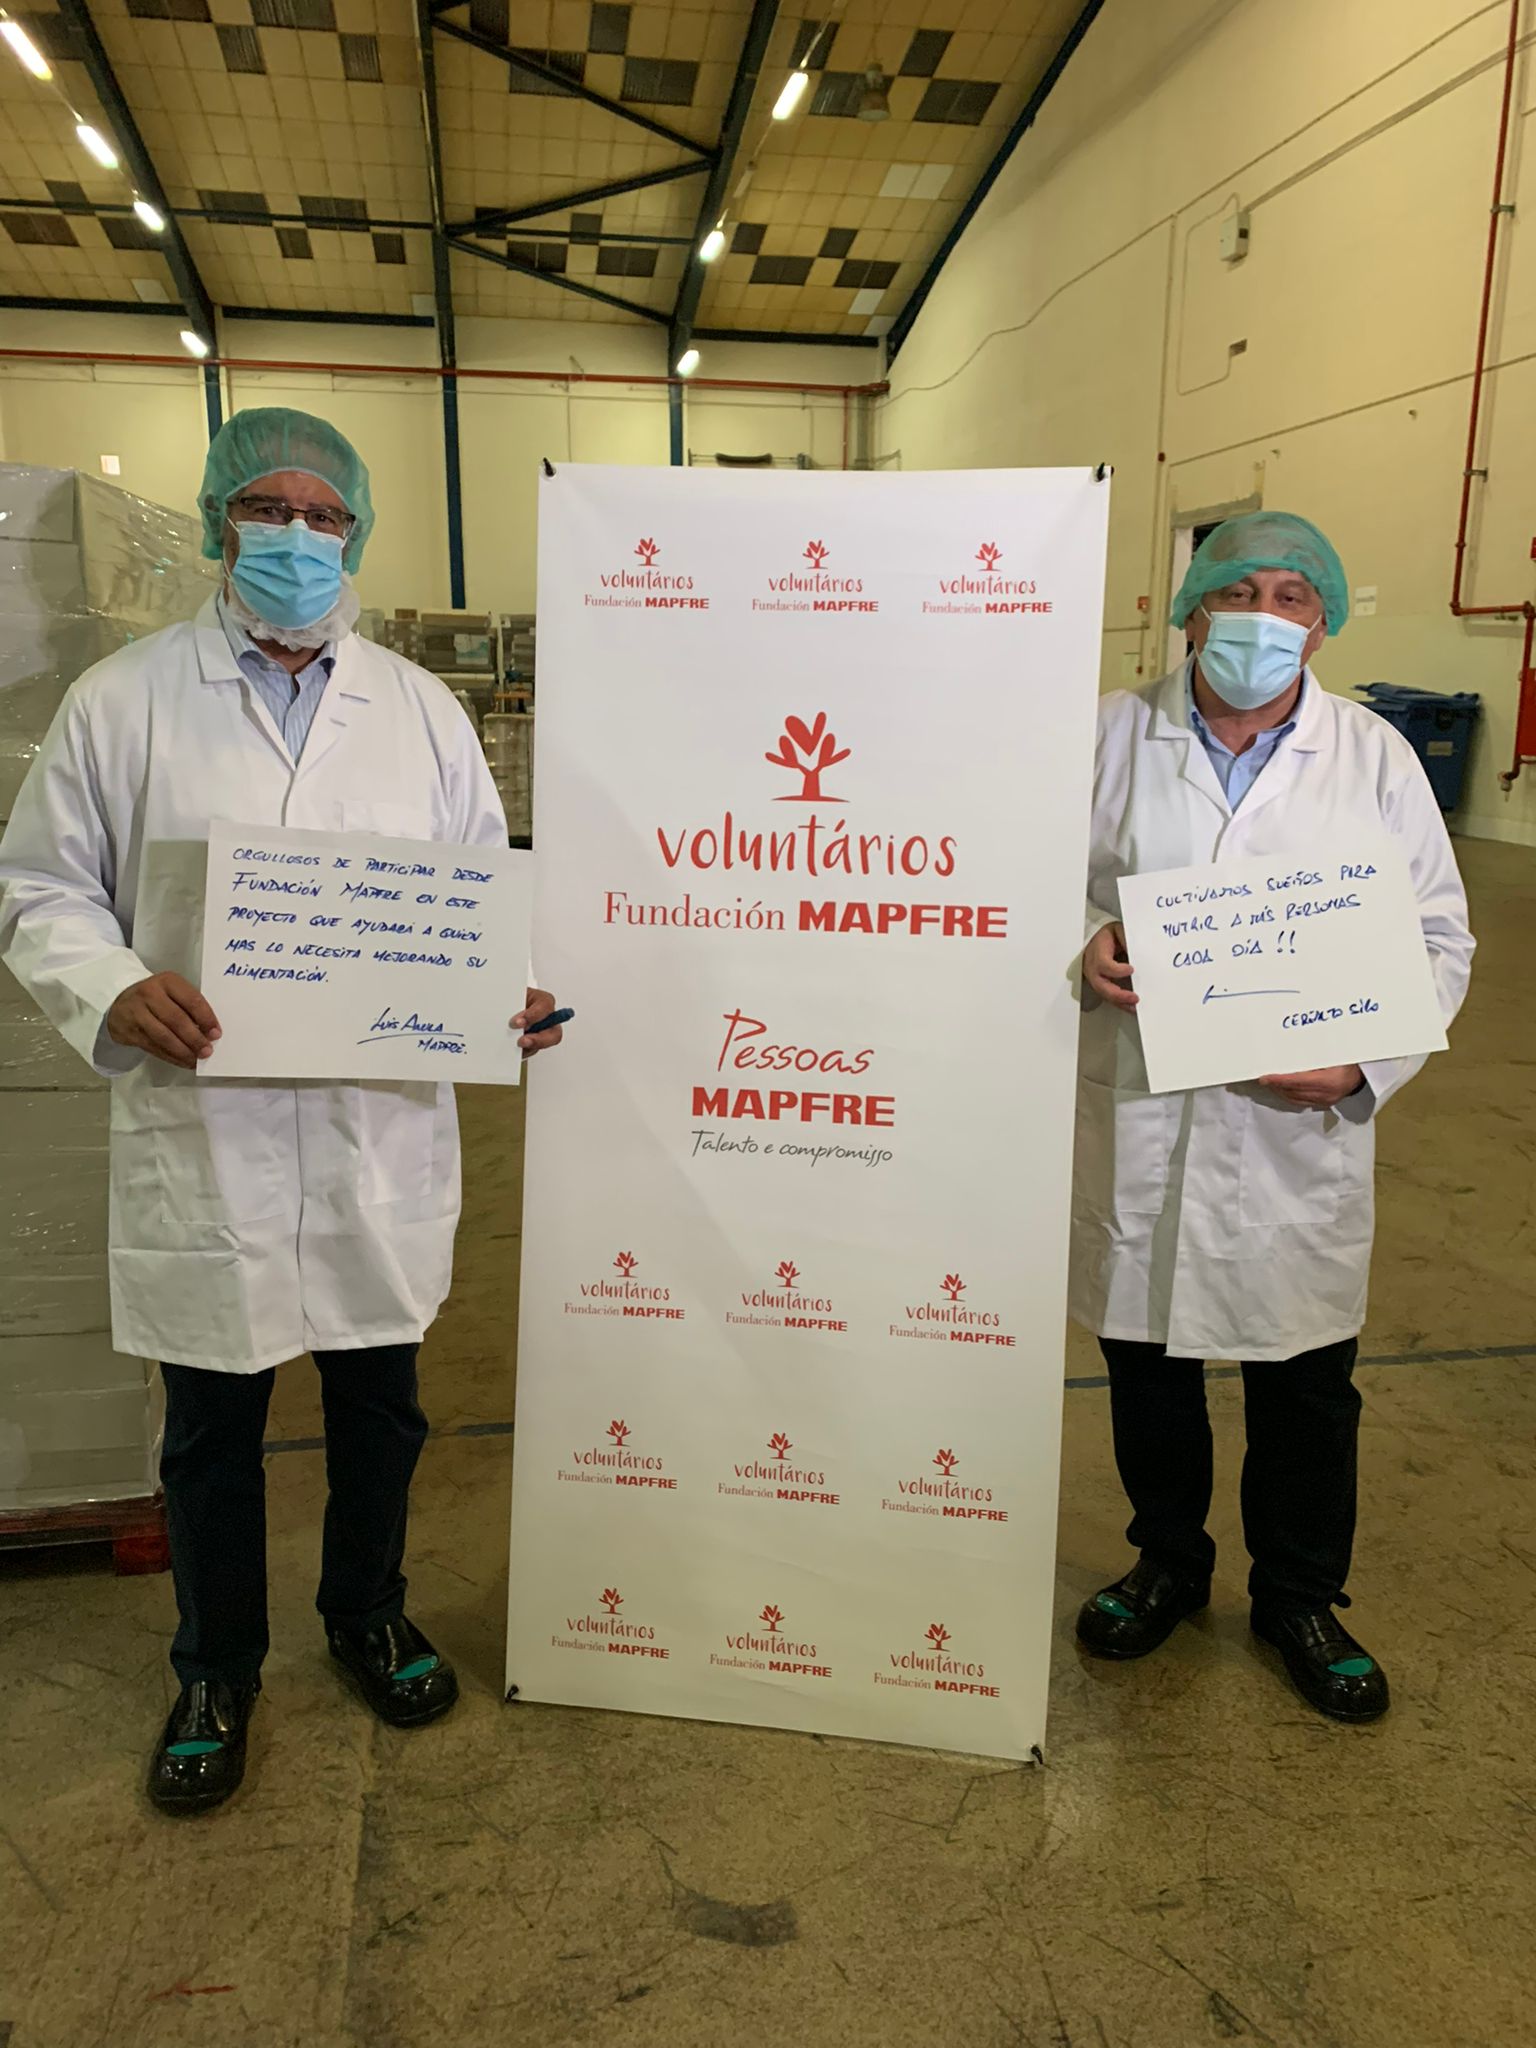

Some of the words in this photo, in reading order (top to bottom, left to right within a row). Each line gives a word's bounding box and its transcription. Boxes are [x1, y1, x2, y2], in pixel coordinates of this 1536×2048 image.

[600, 569, 694, 590] voluntários
[768, 574, 863, 594] voluntários
[939, 576, 1037, 597] voluntários
[584, 594, 642, 608] Fundación
[644, 597, 709, 610] MAPFRE
[752, 598, 810, 612] Fundación
[813, 600, 879, 613] MAPFRE
[922, 601, 982, 615] Fundación
[985, 602, 1053, 615] MAPFRE
[656, 811, 958, 878] voluntários
[232, 848, 321, 867] ORGULLOSOS
[332, 856, 352, 869] DE
[451, 868, 494, 883] DESDE
[416, 893, 438, 906] EN
[446, 897, 481, 910] ESTE
[228, 906, 298, 928] PROYECTO
[309, 913, 343, 928] QUE
[422, 925, 433, 937] A
[604, 891, 785, 932] Fundación
[798, 900, 1009, 939] MAPFRE
[1230, 912, 1242, 928] A
[224, 939, 257, 953] MAS
[266, 942, 284, 953] LO
[373, 949, 453, 968] MEJORANDO
[466, 956, 488, 969] SU
[1172, 948, 1215, 969] CADA
[717, 1008, 875, 1075] Pessoas
[691, 1085, 896, 1128] MAPFRE
[691, 1129, 759, 1160] Talento
[764, 1143, 774, 1154] e
[779, 1142, 894, 1167] compromisso
[580, 1282, 670, 1301] voluntários
[741, 1289, 833, 1312] voluntários
[563, 1302, 620, 1317] Fundación
[622, 1306, 685, 1320] MAPFRE
[725, 1312, 781, 1328] Fundación
[784, 1316, 848, 1332] MAPFRE
[906, 1304, 1000, 1327] voluntários
[888, 1325, 947, 1341] Fundación
[950, 1331, 1016, 1347] MAPFRE
[573, 1447, 663, 1470] voluntários
[557, 1469, 612, 1485] Fundación
[615, 1474, 677, 1489] MAPFRE
[733, 1460, 825, 1485] voluntários
[717, 1483, 774, 1499] Fundación
[776, 1489, 840, 1505] MAPFRE
[898, 1477, 992, 1503] voluntários
[881, 1499, 939, 1516] Fundación
[942, 1506, 1008, 1522] MAPFRE
[566, 1615, 655, 1640] voluntários
[551, 1635, 605, 1653] Fundación
[608, 1642, 670, 1658] MAPFRE
[726, 1632, 817, 1658] voluntários
[709, 1653, 766, 1671] Fundación
[768, 1660, 832, 1677] MAPFRE
[890, 1650, 985, 1678] voluntários
[873, 1671, 931, 1690] Fundación
[934, 1680, 1000, 1698] MAPFRE
